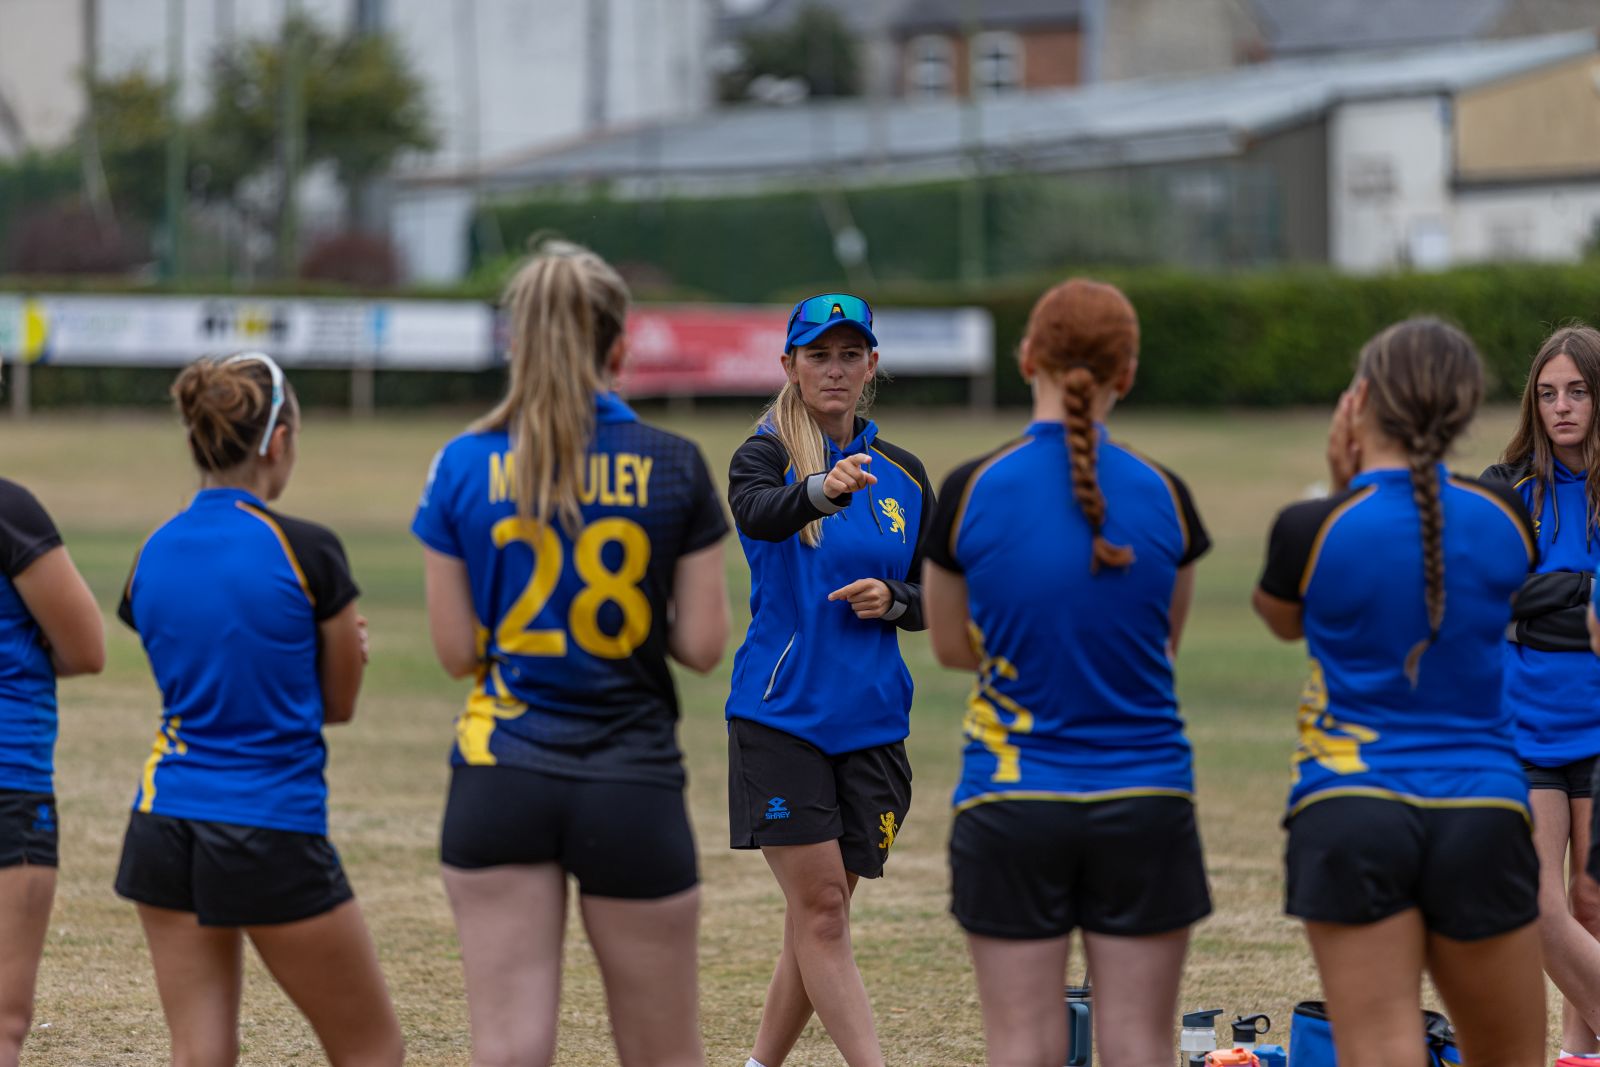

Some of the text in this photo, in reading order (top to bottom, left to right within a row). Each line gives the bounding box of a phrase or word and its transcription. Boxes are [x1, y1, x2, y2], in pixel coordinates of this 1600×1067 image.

[489, 452, 653, 508] MULEY
[491, 516, 652, 659] 28
[765, 811, 791, 820] SHREY
